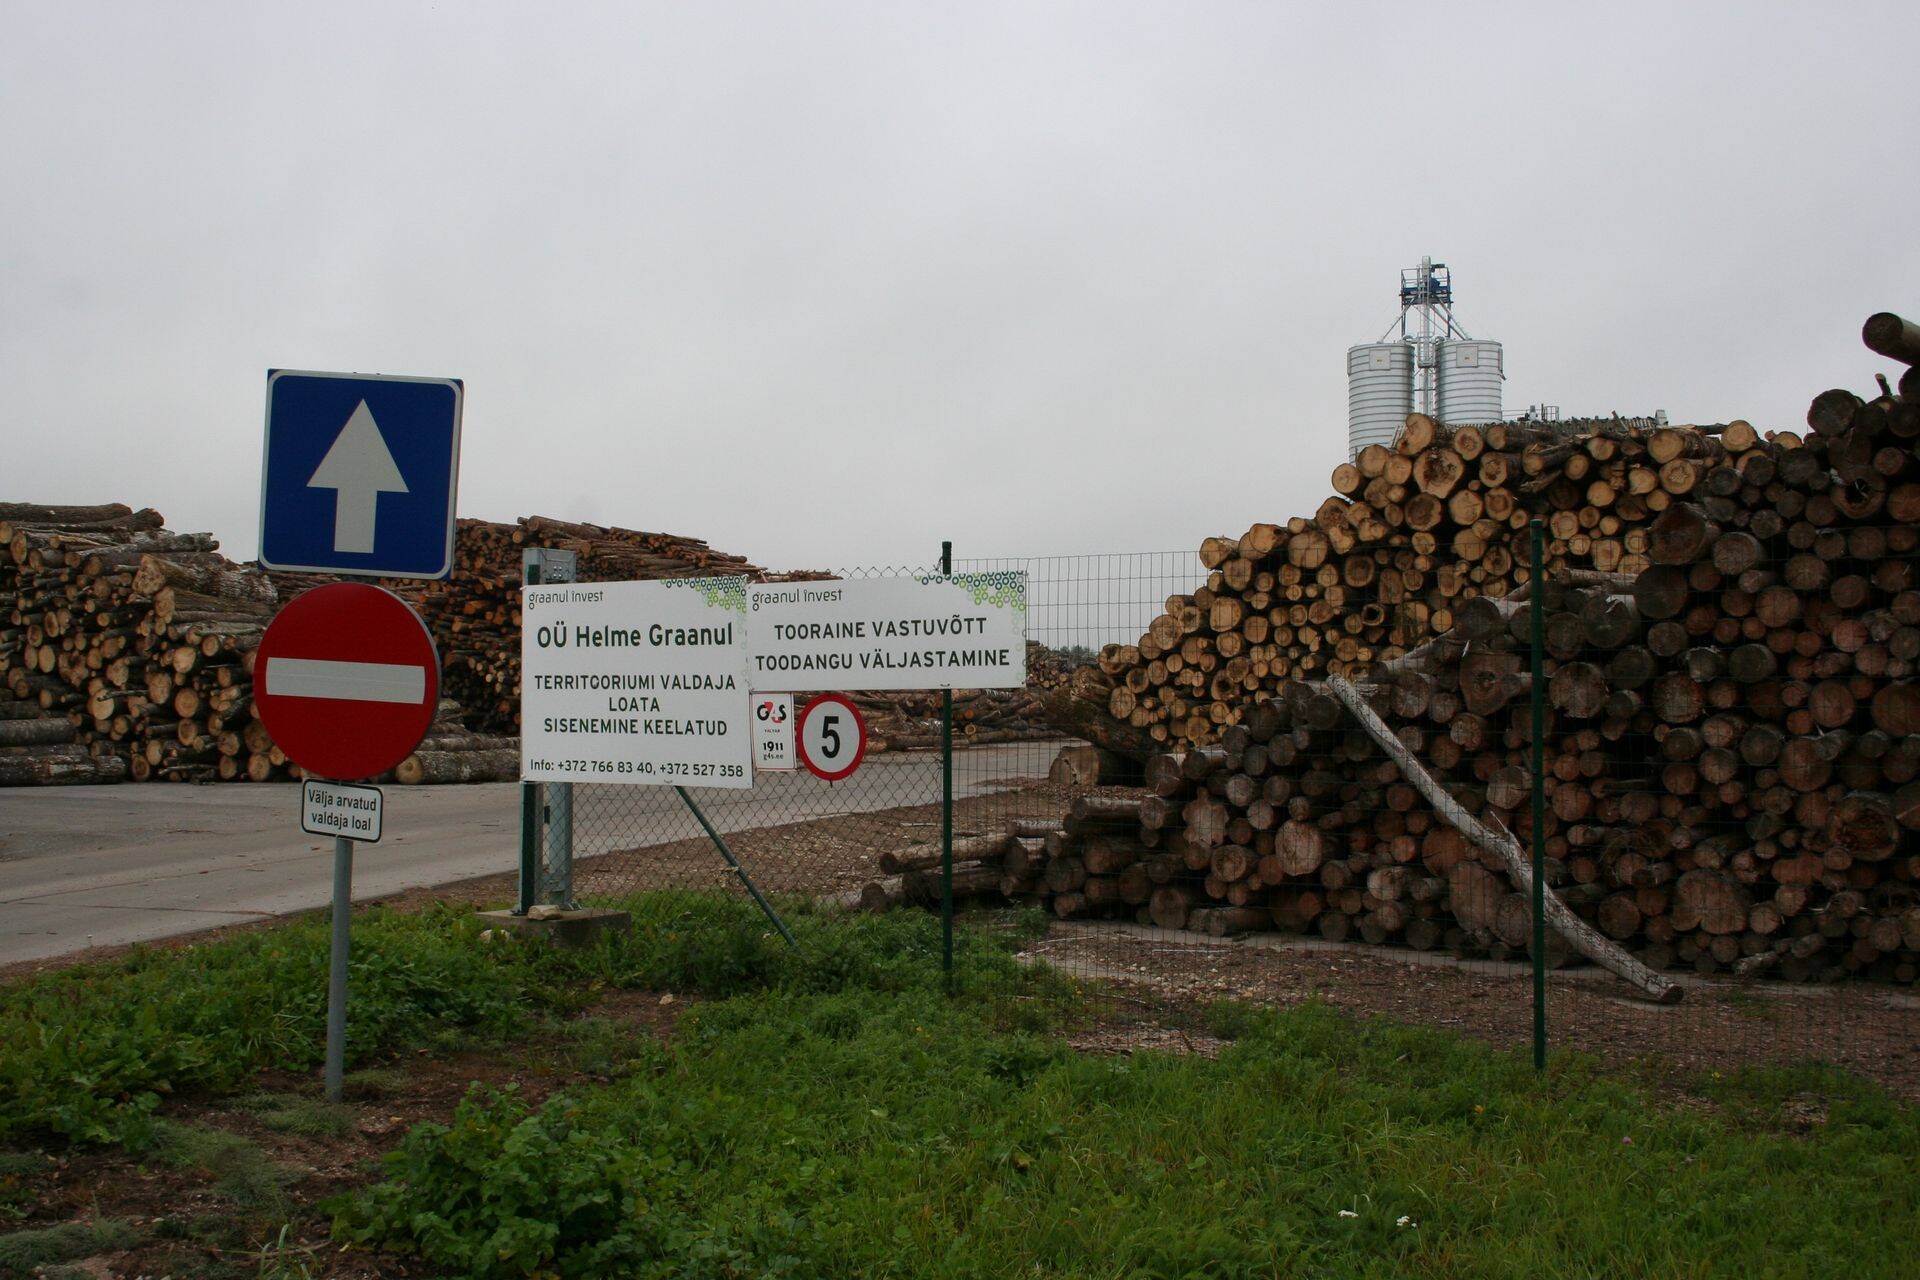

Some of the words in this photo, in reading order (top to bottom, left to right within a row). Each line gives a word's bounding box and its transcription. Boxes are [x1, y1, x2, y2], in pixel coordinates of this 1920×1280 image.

[529, 590, 569, 610] graanul
[571, 590, 604, 602] invest
[752, 588, 800, 611] graanul
[803, 589, 843, 602] invest
[537, 621, 567, 648] OÜ
[576, 625, 641, 648] Helme
[649, 622, 733, 647] Graanul
[774, 621, 866, 640] TOORAINE
[872, 614, 987, 637] VASTUVÕTT
[755, 653, 853, 671] TOODANGU
[860, 649, 1010, 669] VÄLJASTAMINE
[535, 674, 655, 690] TERRITOORIUMI
[660, 675, 736, 690] VALDAJA
[608, 697, 660, 712] LOATA
[544, 718, 639, 734] SISENEMINE
[644, 720, 728, 736] KEELATUD
[821, 715, 841, 759] 5
[763, 741, 783, 751] 1911
[530, 759, 554, 771] Info:
[557, 760, 586, 772] +372
[591, 761, 614, 773] 766
[617, 761, 633, 773] 83
[636, 762, 656, 775] 40,
[659, 763, 689, 775] +372
[692, 764, 715, 776] 527
[719, 765, 744, 777] 358
[308, 789, 334, 808] Välja
[336, 796, 377, 811] arvatud
[311, 811, 349, 830] valdaja
[351, 815, 371, 831] loal
